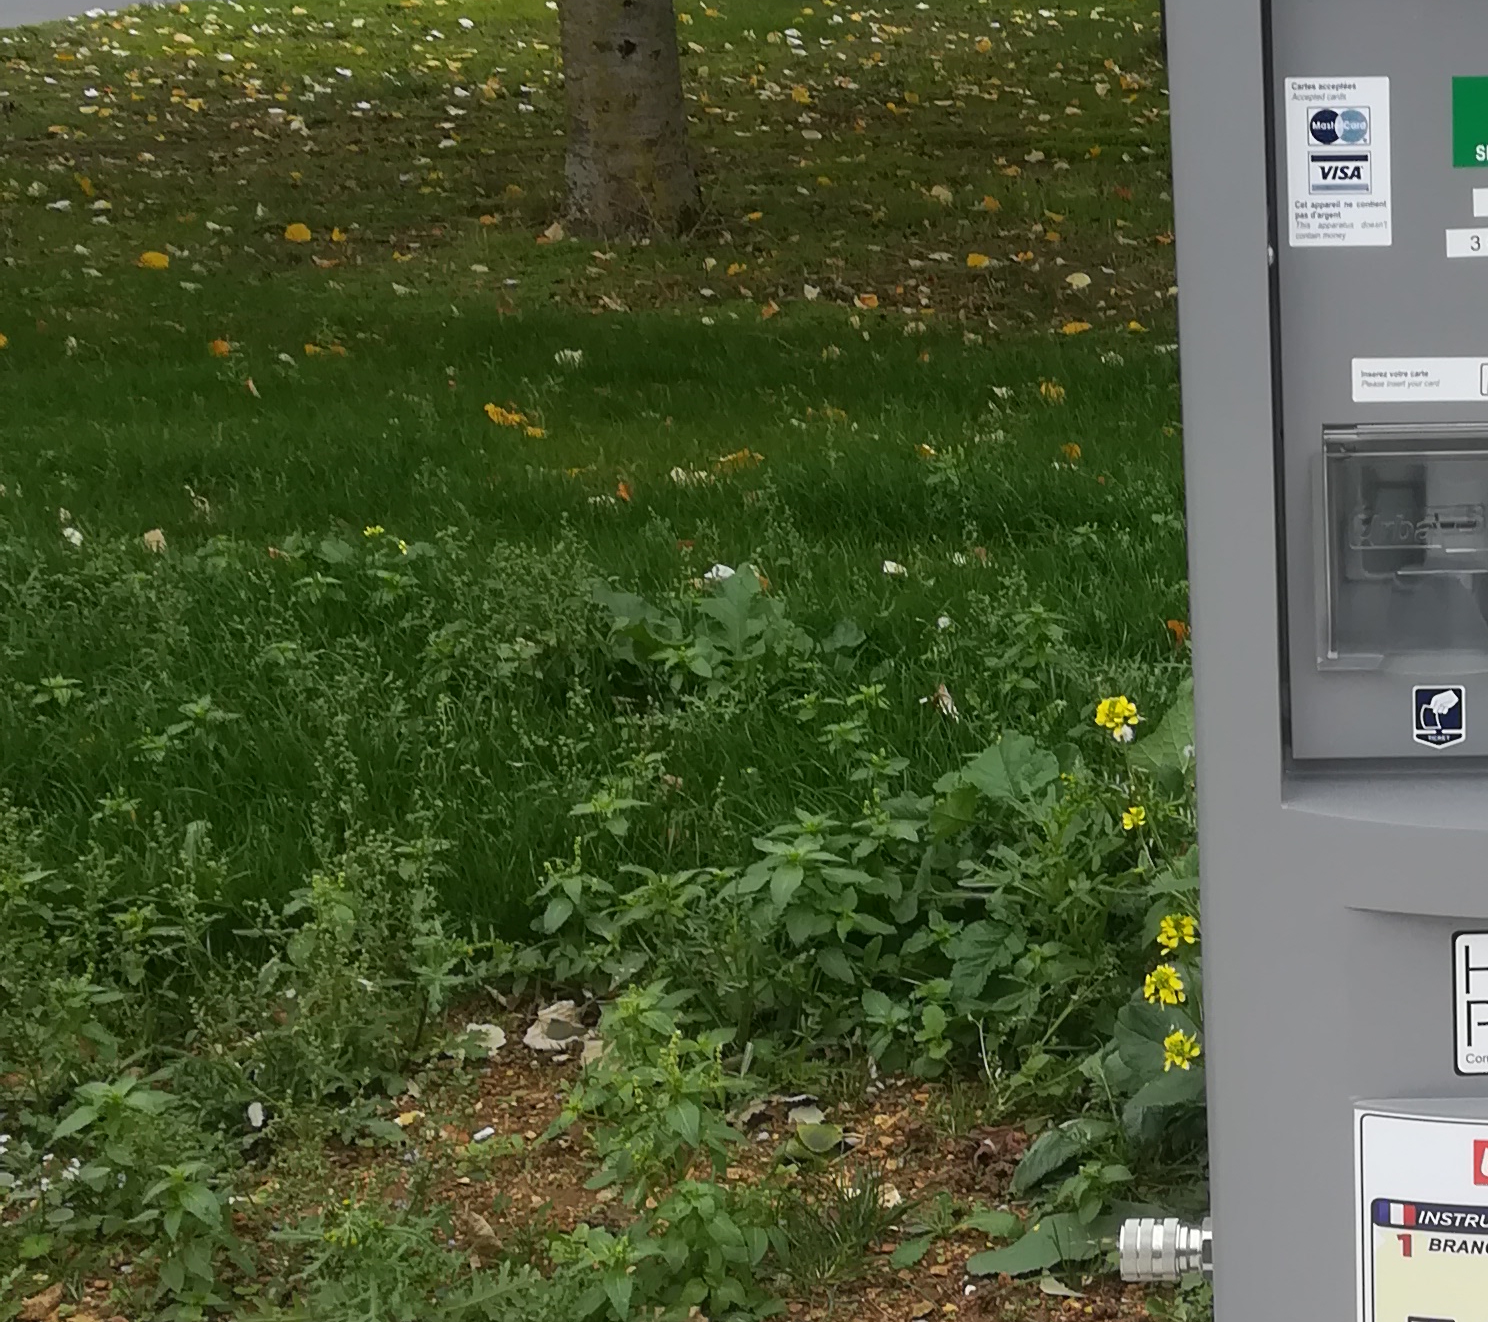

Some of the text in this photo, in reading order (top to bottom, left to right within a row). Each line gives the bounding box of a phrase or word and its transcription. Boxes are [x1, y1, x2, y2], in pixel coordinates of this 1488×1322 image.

[1291, 82, 1316, 90] Cartes
[1319, 166, 1362, 180] VISA
[1295, 200, 1308, 209] Cet
[1311, 201, 1340, 209] appareil
[1295, 211, 1341, 220] pas d'argent
[1470, 235, 1481, 252] 3
[1397, 1234, 1412, 1257] 1
